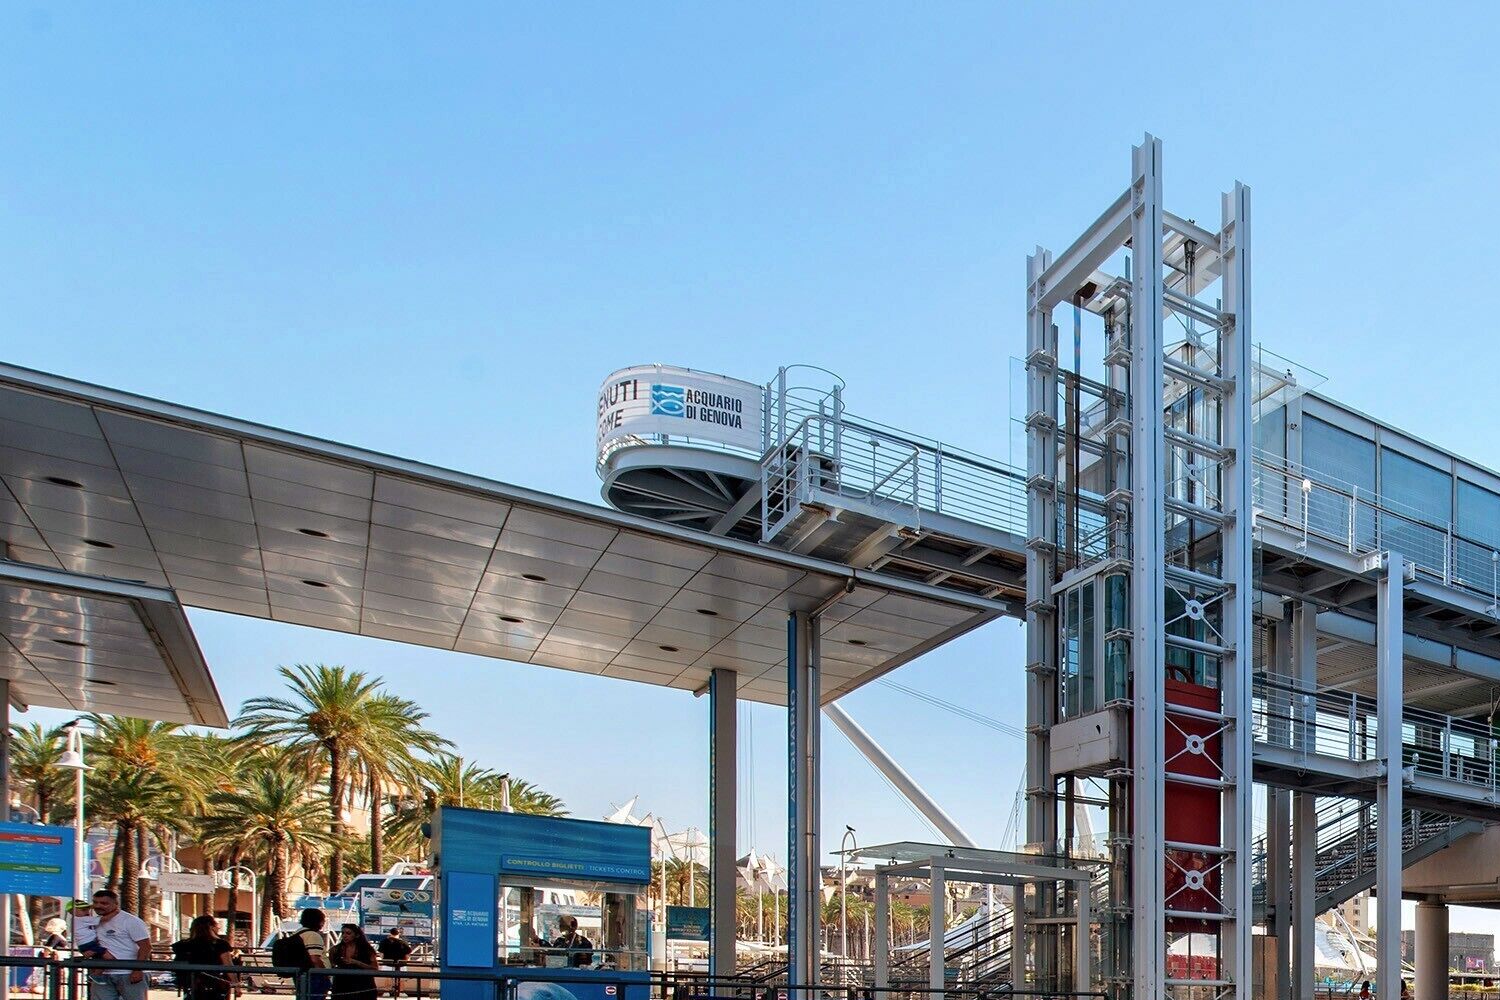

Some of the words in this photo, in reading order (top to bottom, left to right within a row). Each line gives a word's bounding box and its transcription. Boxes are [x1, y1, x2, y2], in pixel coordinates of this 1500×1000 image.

[599, 379, 638, 418] ENUTI
[686, 389, 742, 413] ACQUARIO
[686, 405, 697, 420] DI
[700, 407, 743, 429] GENOVA
[507, 859, 551, 868] CONTROLLO
[551, 862, 585, 870] BIGLIETTI
[589, 865, 615, 873] TICKETS
[615, 867, 646, 876] CONTROL
